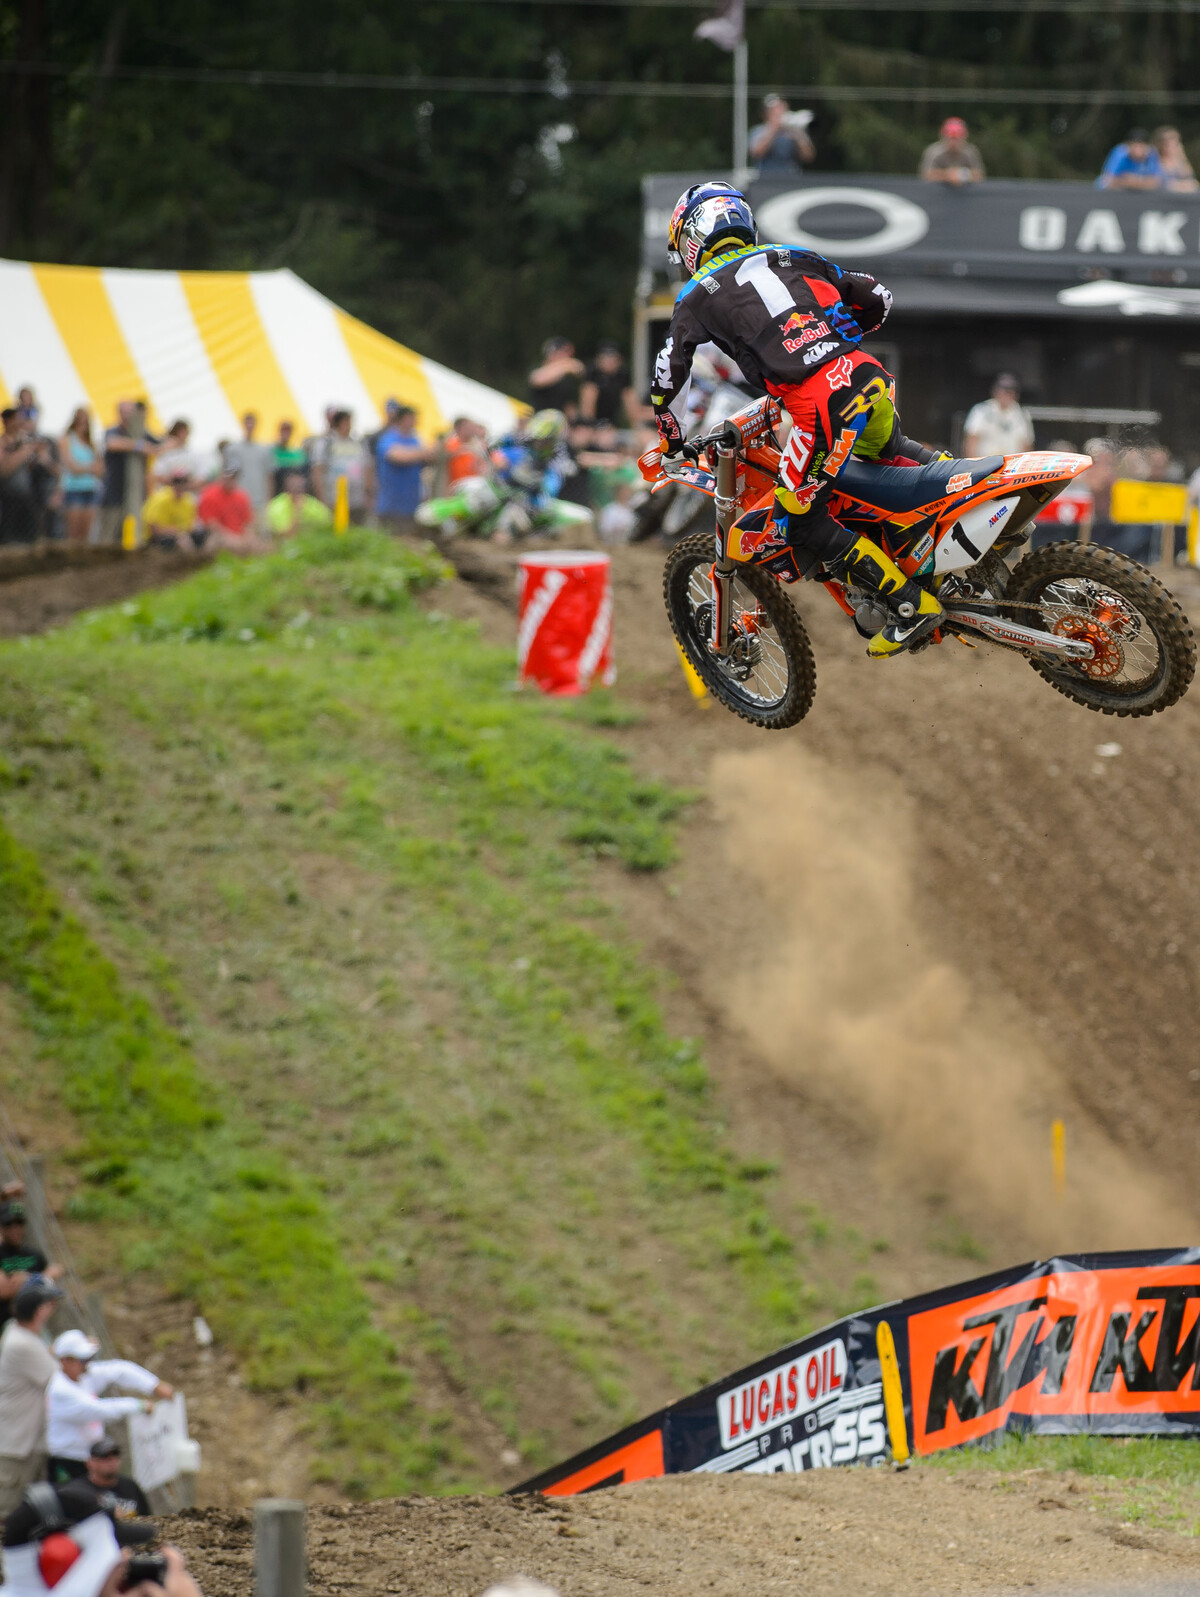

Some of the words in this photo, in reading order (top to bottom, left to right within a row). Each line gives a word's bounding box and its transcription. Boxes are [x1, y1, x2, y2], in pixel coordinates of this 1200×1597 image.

[734, 252, 797, 319] 1
[802, 341, 840, 365] KTM
[822, 428, 858, 478] KTM
[1012, 471, 1065, 486] DUNLOP
[951, 521, 983, 562] 1
[924, 1296, 1078, 1436] KTM
[729, 1365, 799, 1440] LUCAS
[806, 1346, 842, 1401] OIL
[759, 1413, 818, 1453] PRO
